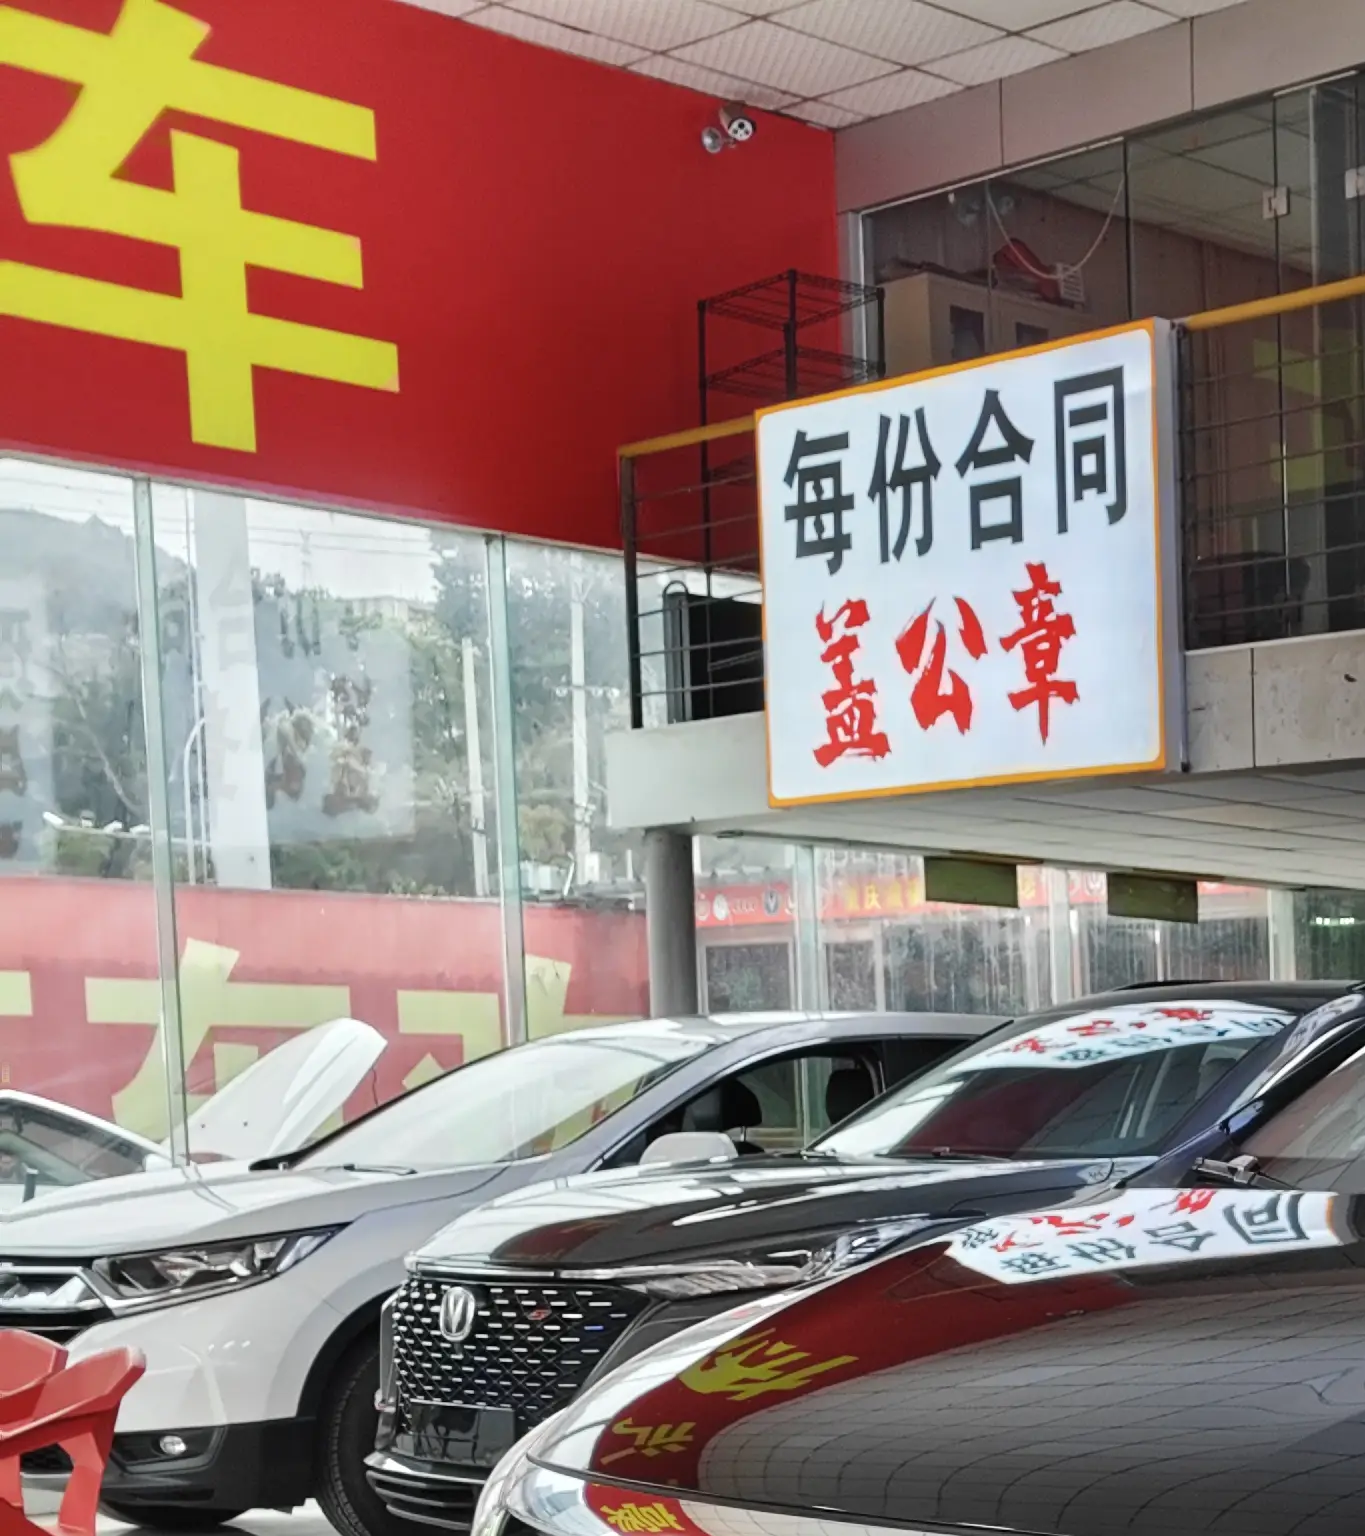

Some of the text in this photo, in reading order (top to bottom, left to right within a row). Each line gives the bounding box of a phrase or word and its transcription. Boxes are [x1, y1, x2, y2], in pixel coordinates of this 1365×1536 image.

[783, 365, 1129, 576] 每份合同
[813, 562, 1080, 768] 盖公章
